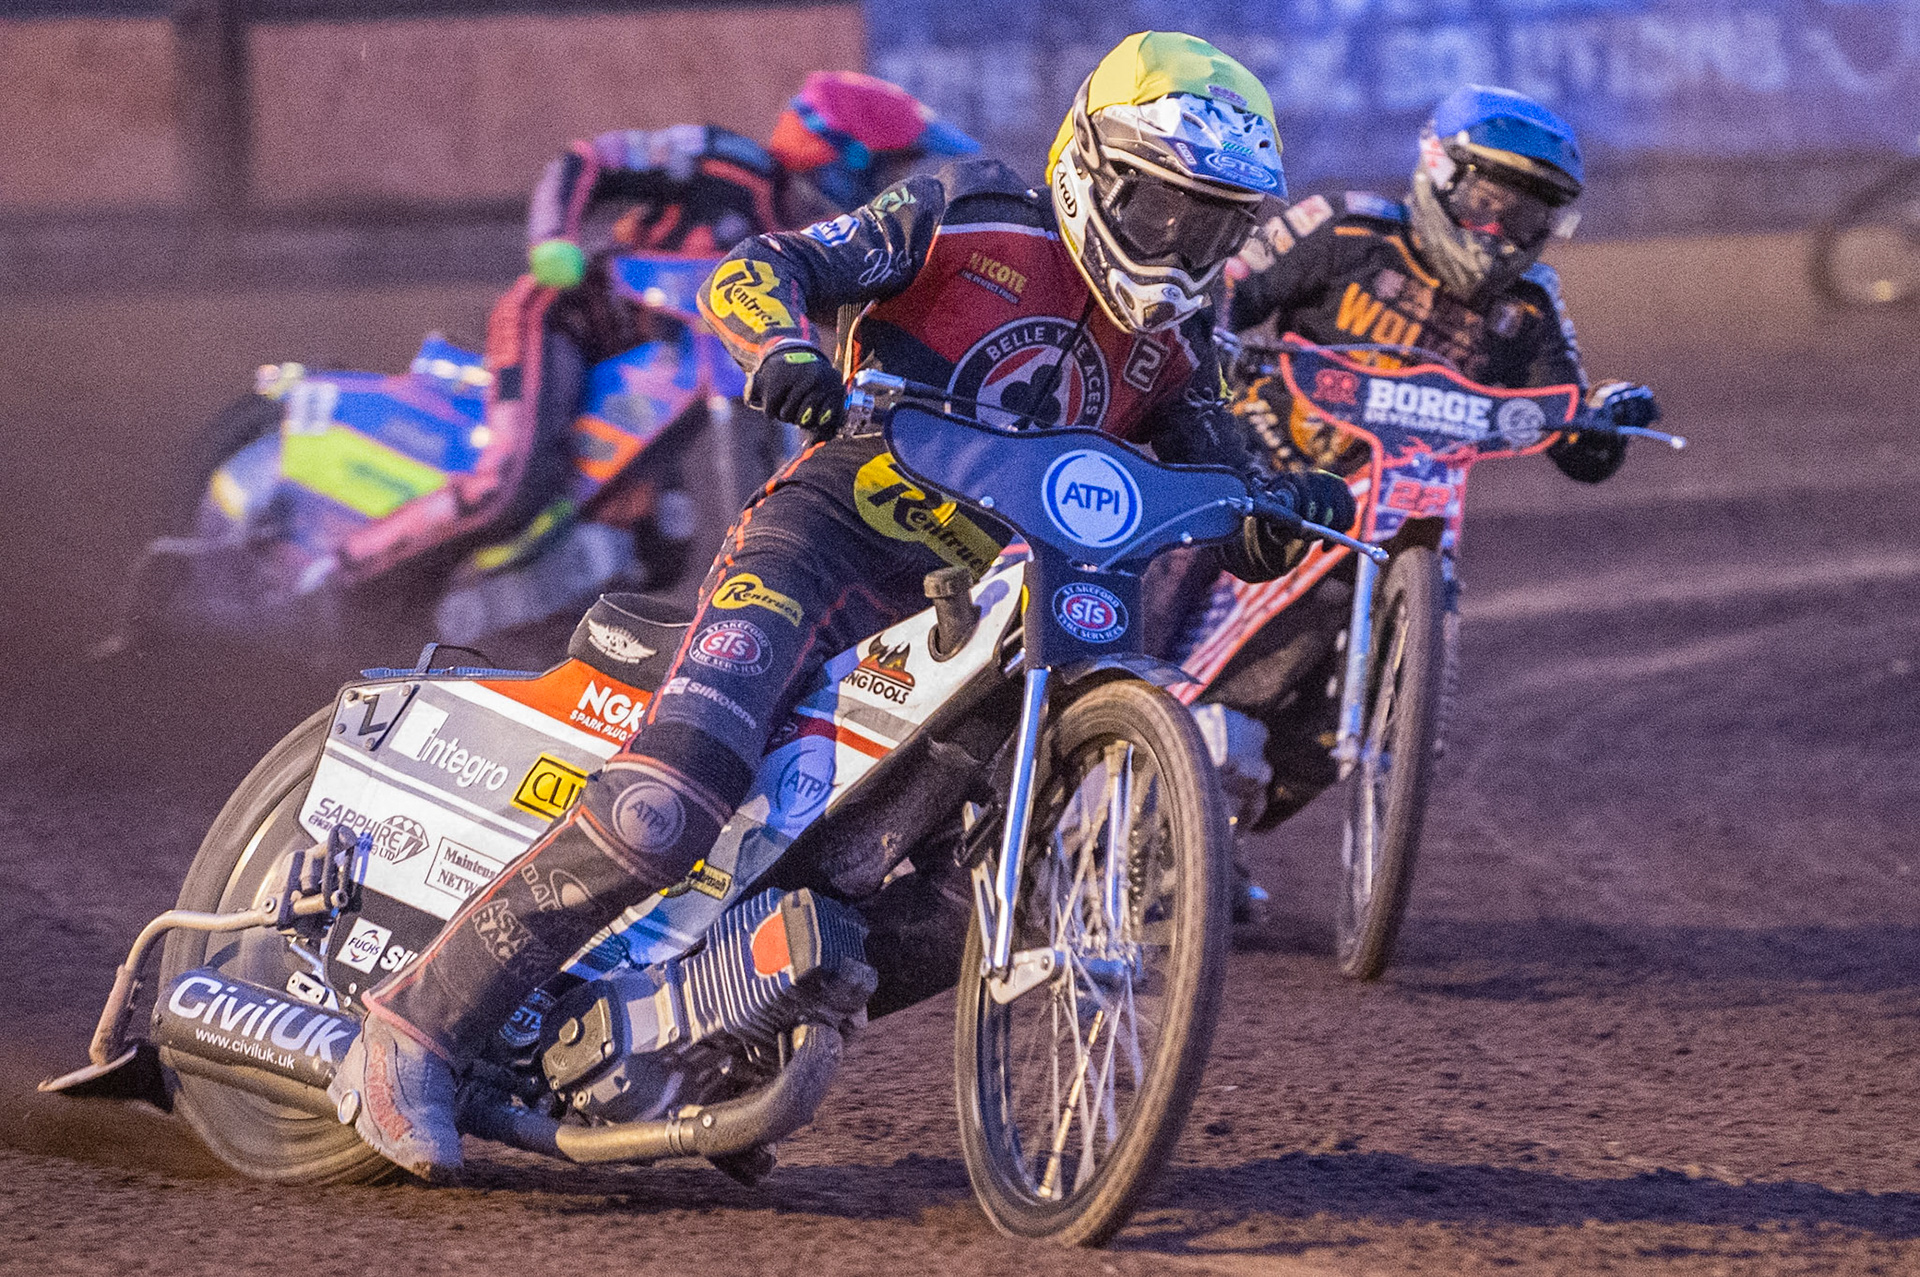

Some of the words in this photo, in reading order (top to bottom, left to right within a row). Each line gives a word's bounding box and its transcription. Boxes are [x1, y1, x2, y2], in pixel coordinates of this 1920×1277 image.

[1057, 171, 1077, 210] Arai
[986, 326, 1045, 361] BELLE
[1056, 328, 1089, 358] VE
[1084, 364, 1101, 415] ACES
[1132, 346, 1161, 384] 2
[1365, 378, 1493, 429] BORGE
[1062, 482, 1121, 515] ATPI
[1071, 598, 1107, 625] STS
[707, 632, 750, 657] STS
[569, 709, 605, 732] SPARK
[577, 680, 646, 733] NGK
[415, 727, 509, 791] integro
[784, 769, 828, 801] ATPI
[314, 797, 404, 852] SAPPHIRE
[626, 799, 671, 835] ATPI
[379, 846, 397, 862] LTD
[348, 936, 381, 956] FUCHS
[195, 1027, 296, 1071] www.civiluk.uk
